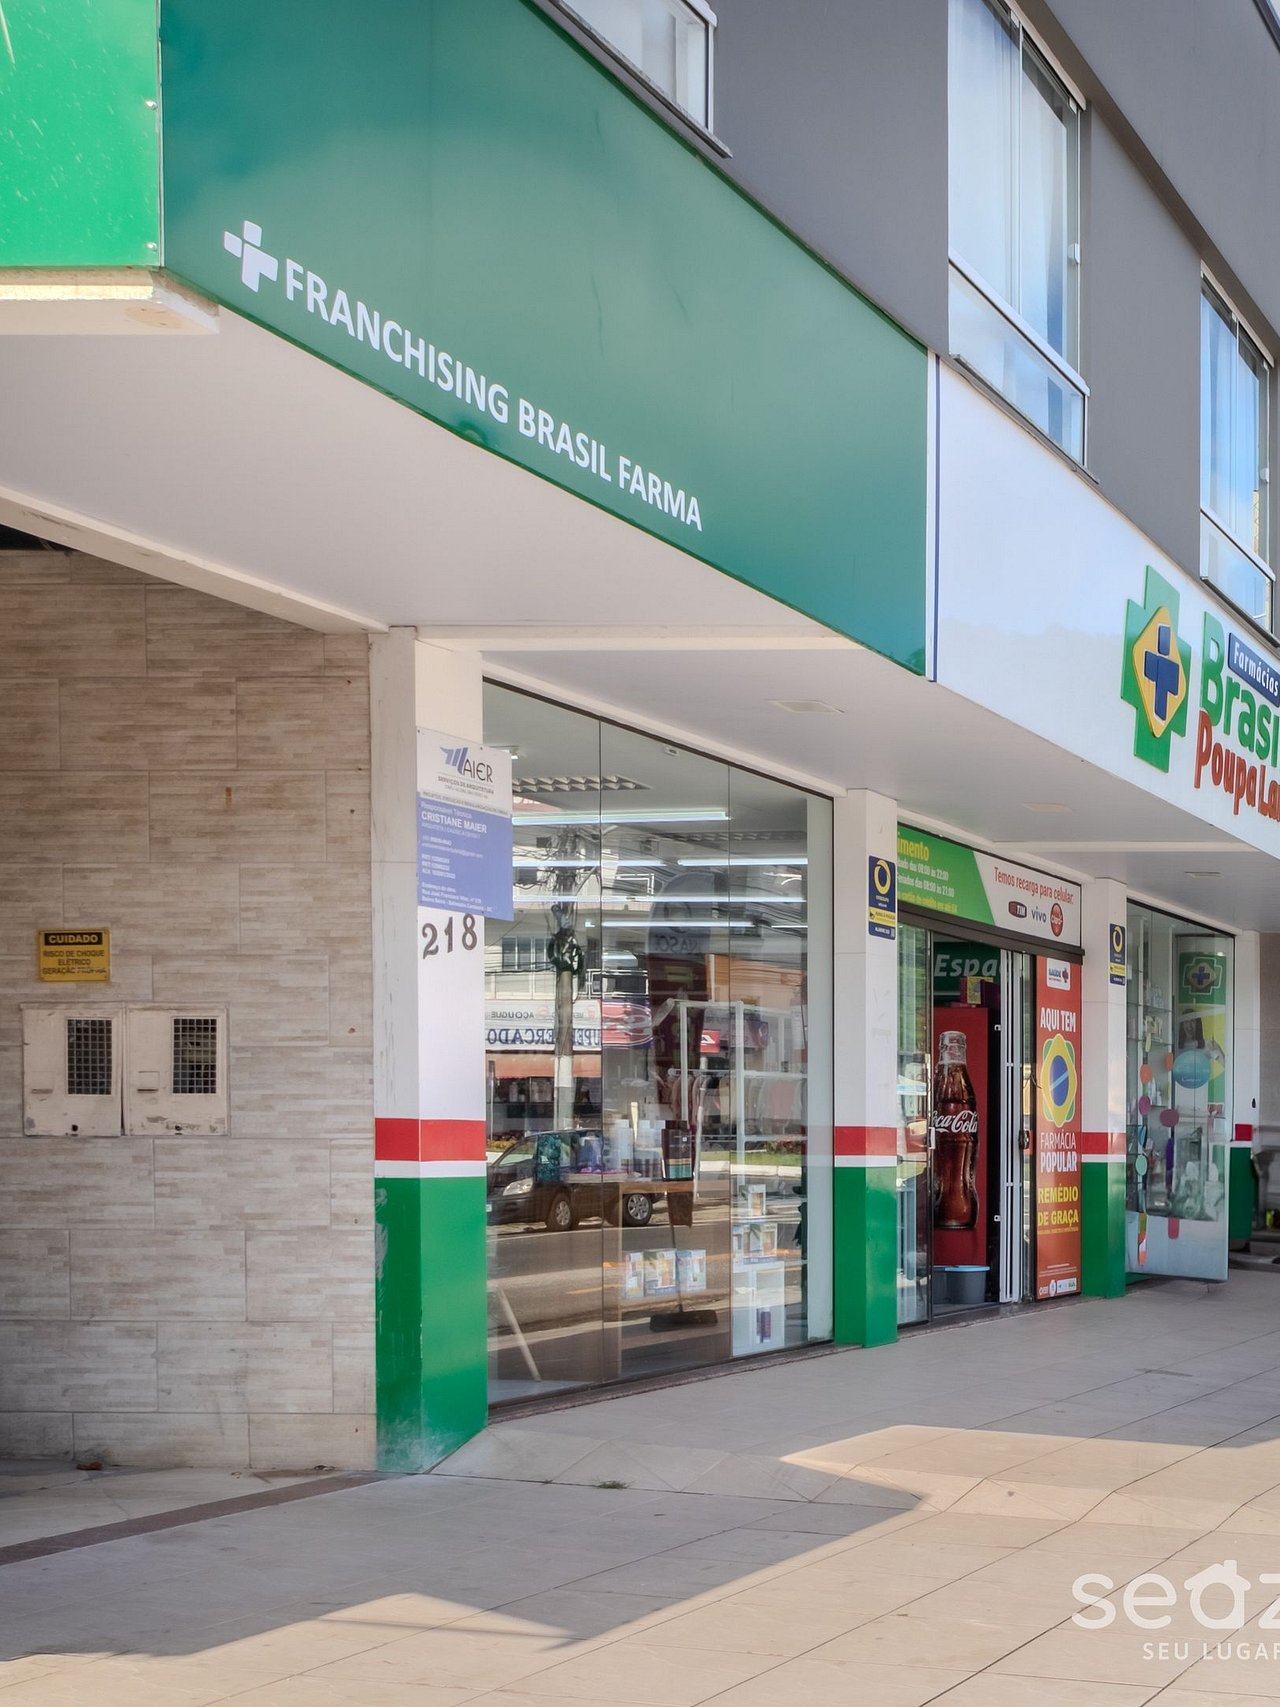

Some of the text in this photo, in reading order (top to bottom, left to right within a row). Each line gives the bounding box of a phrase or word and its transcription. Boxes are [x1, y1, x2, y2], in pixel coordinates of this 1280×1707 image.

[284, 257, 703, 531] FRANCHISING BRASIL FARMA
[1234, 641, 1279, 697] Farmácias
[421, 811, 487, 833] CRISTIANE MAIER
[994, 867, 1015, 886] Temos
[1015, 875, 1039, 896] recarga
[1039, 885, 1053, 899] para
[1031, 906, 1047, 923] vivo
[49, 934, 99, 944] CUIDADO
[422, 913, 477, 959] 218
[934, 954, 1001, 977] Espa
[1040, 1007, 1076, 1032] AQUI TEM
[1040, 1129, 1076, 1150] FARMÁCIA
[1040, 1151, 1077, 1172] POPULAR
[1038, 1184, 1079, 1204] REMÉDIO
[1038, 1208, 1079, 1228] DE GRAÇA
